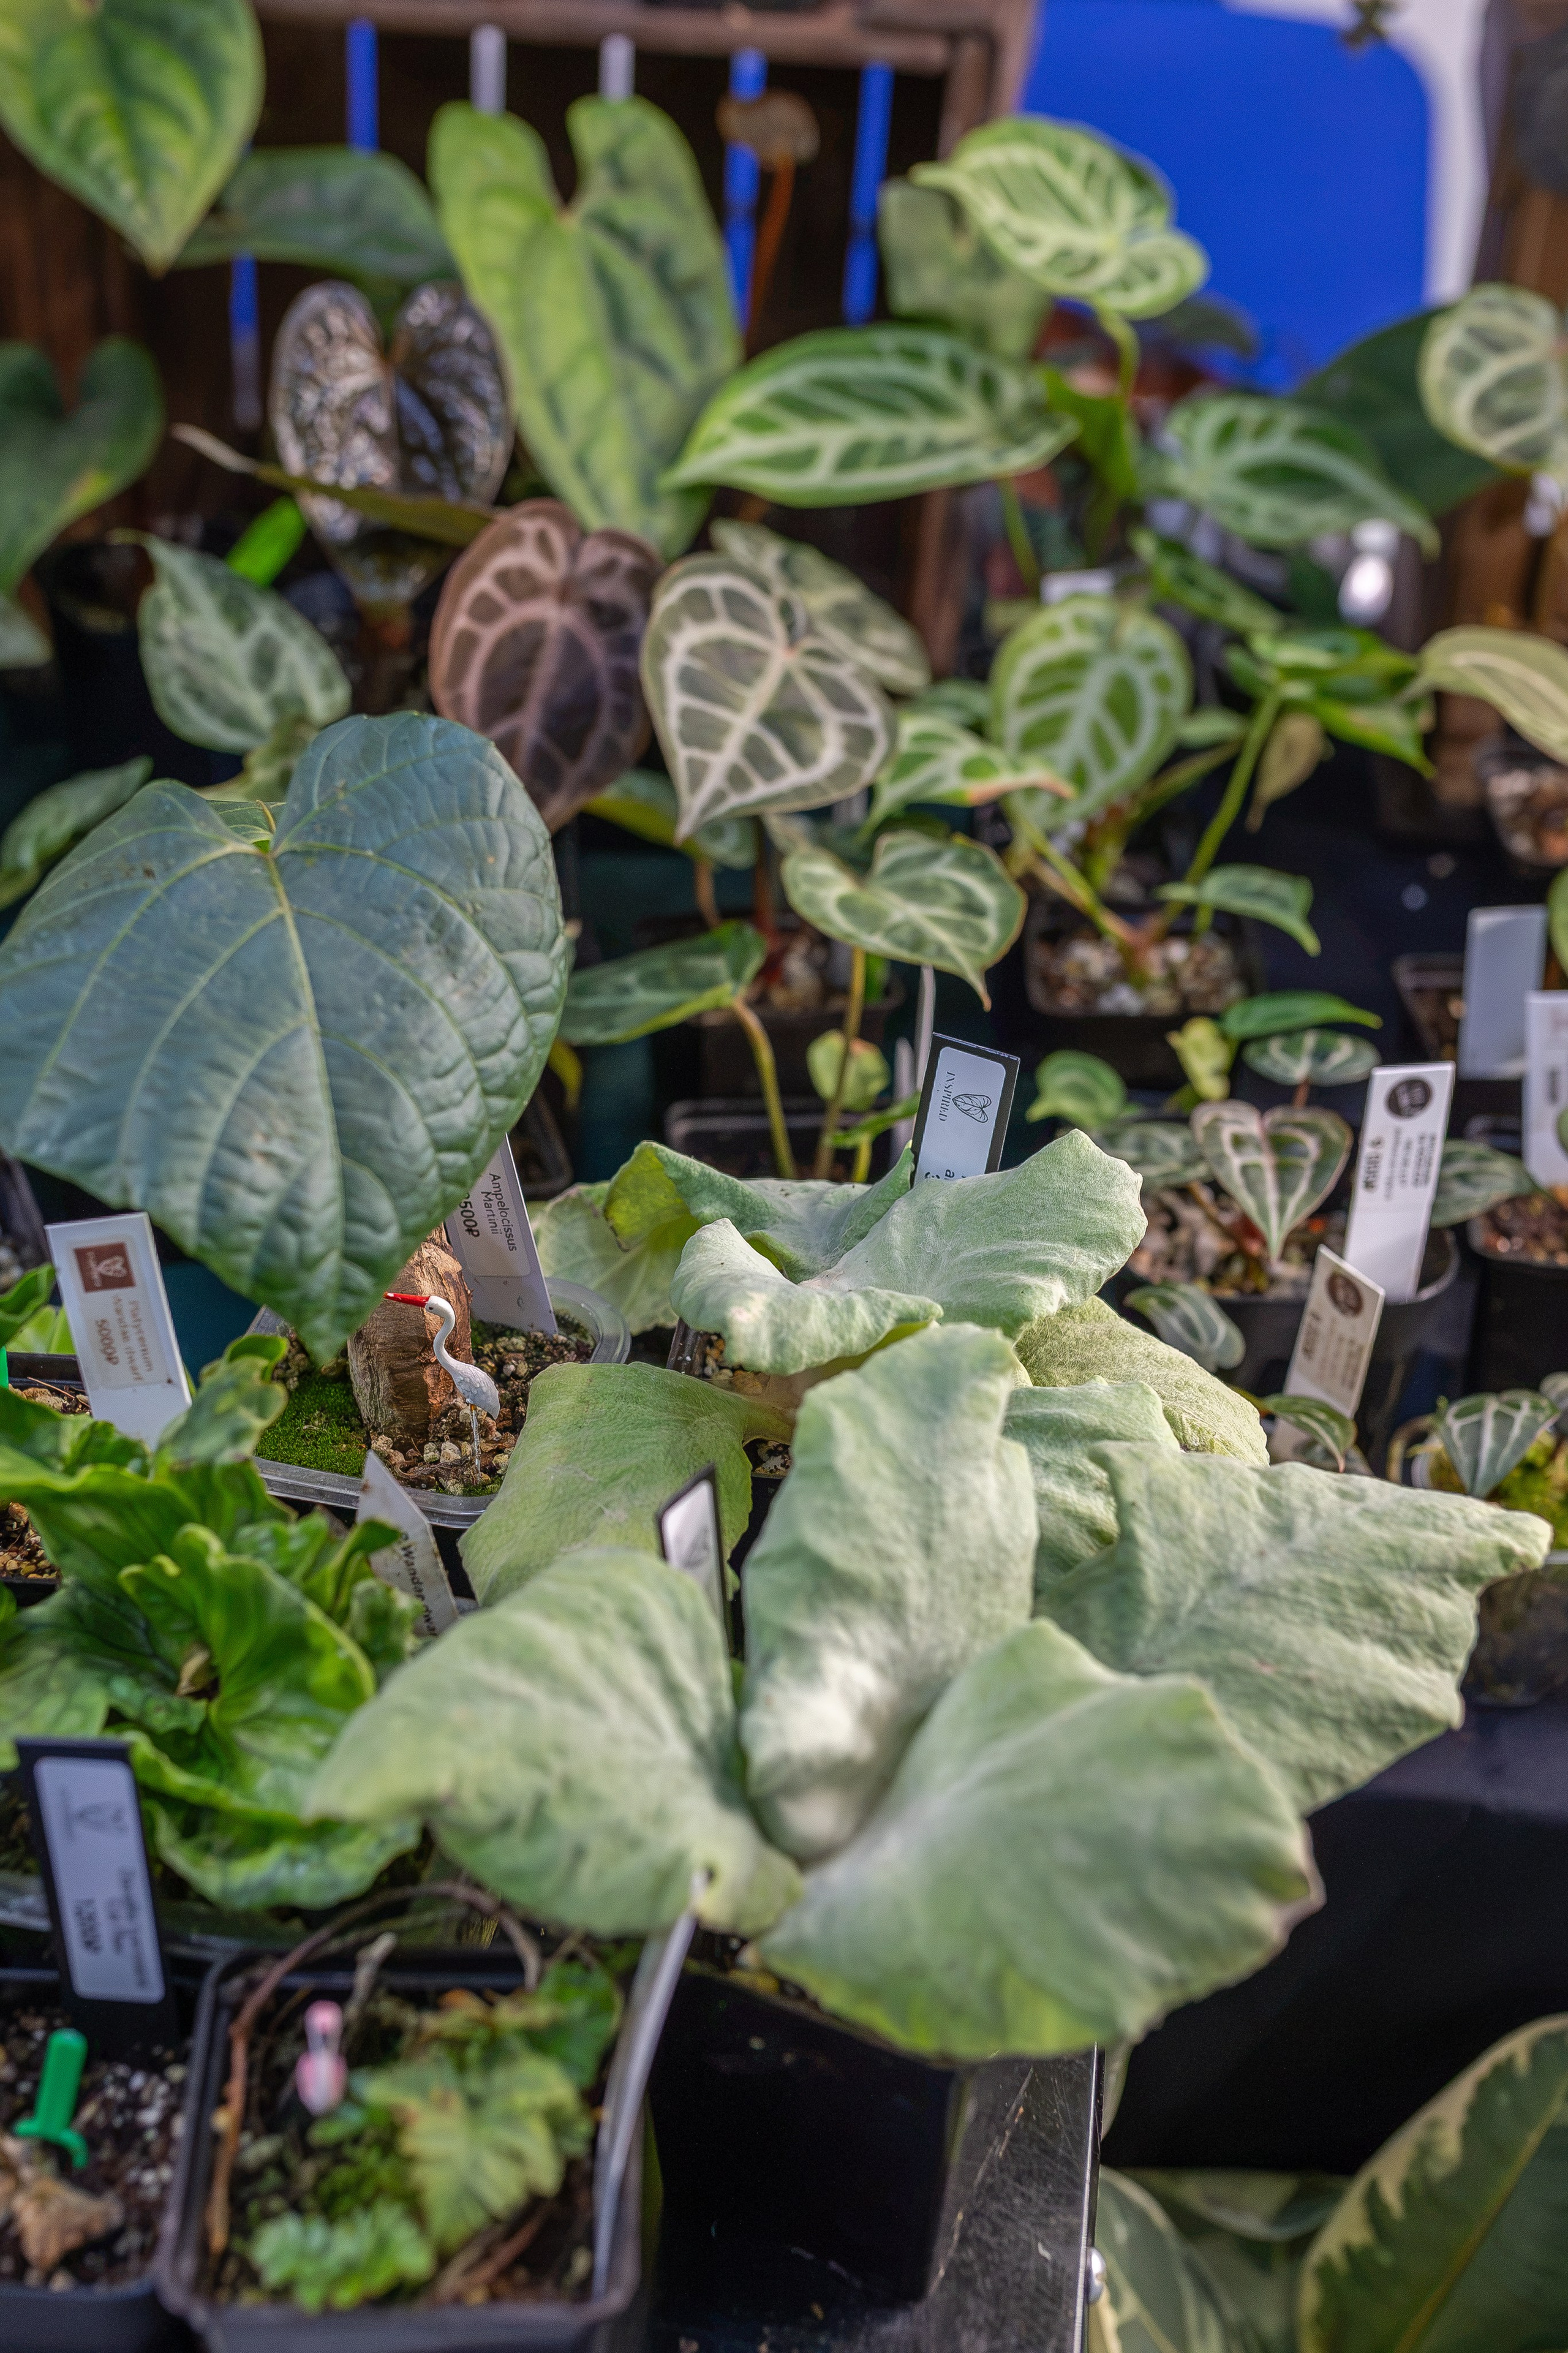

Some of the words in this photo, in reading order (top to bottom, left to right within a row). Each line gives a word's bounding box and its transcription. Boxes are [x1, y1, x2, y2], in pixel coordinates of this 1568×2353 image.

[938, 1071, 956, 1122] INSPIRED
[481, 1191, 503, 1234] Martinii
[489, 1173, 517, 1252] Ampelocissus
